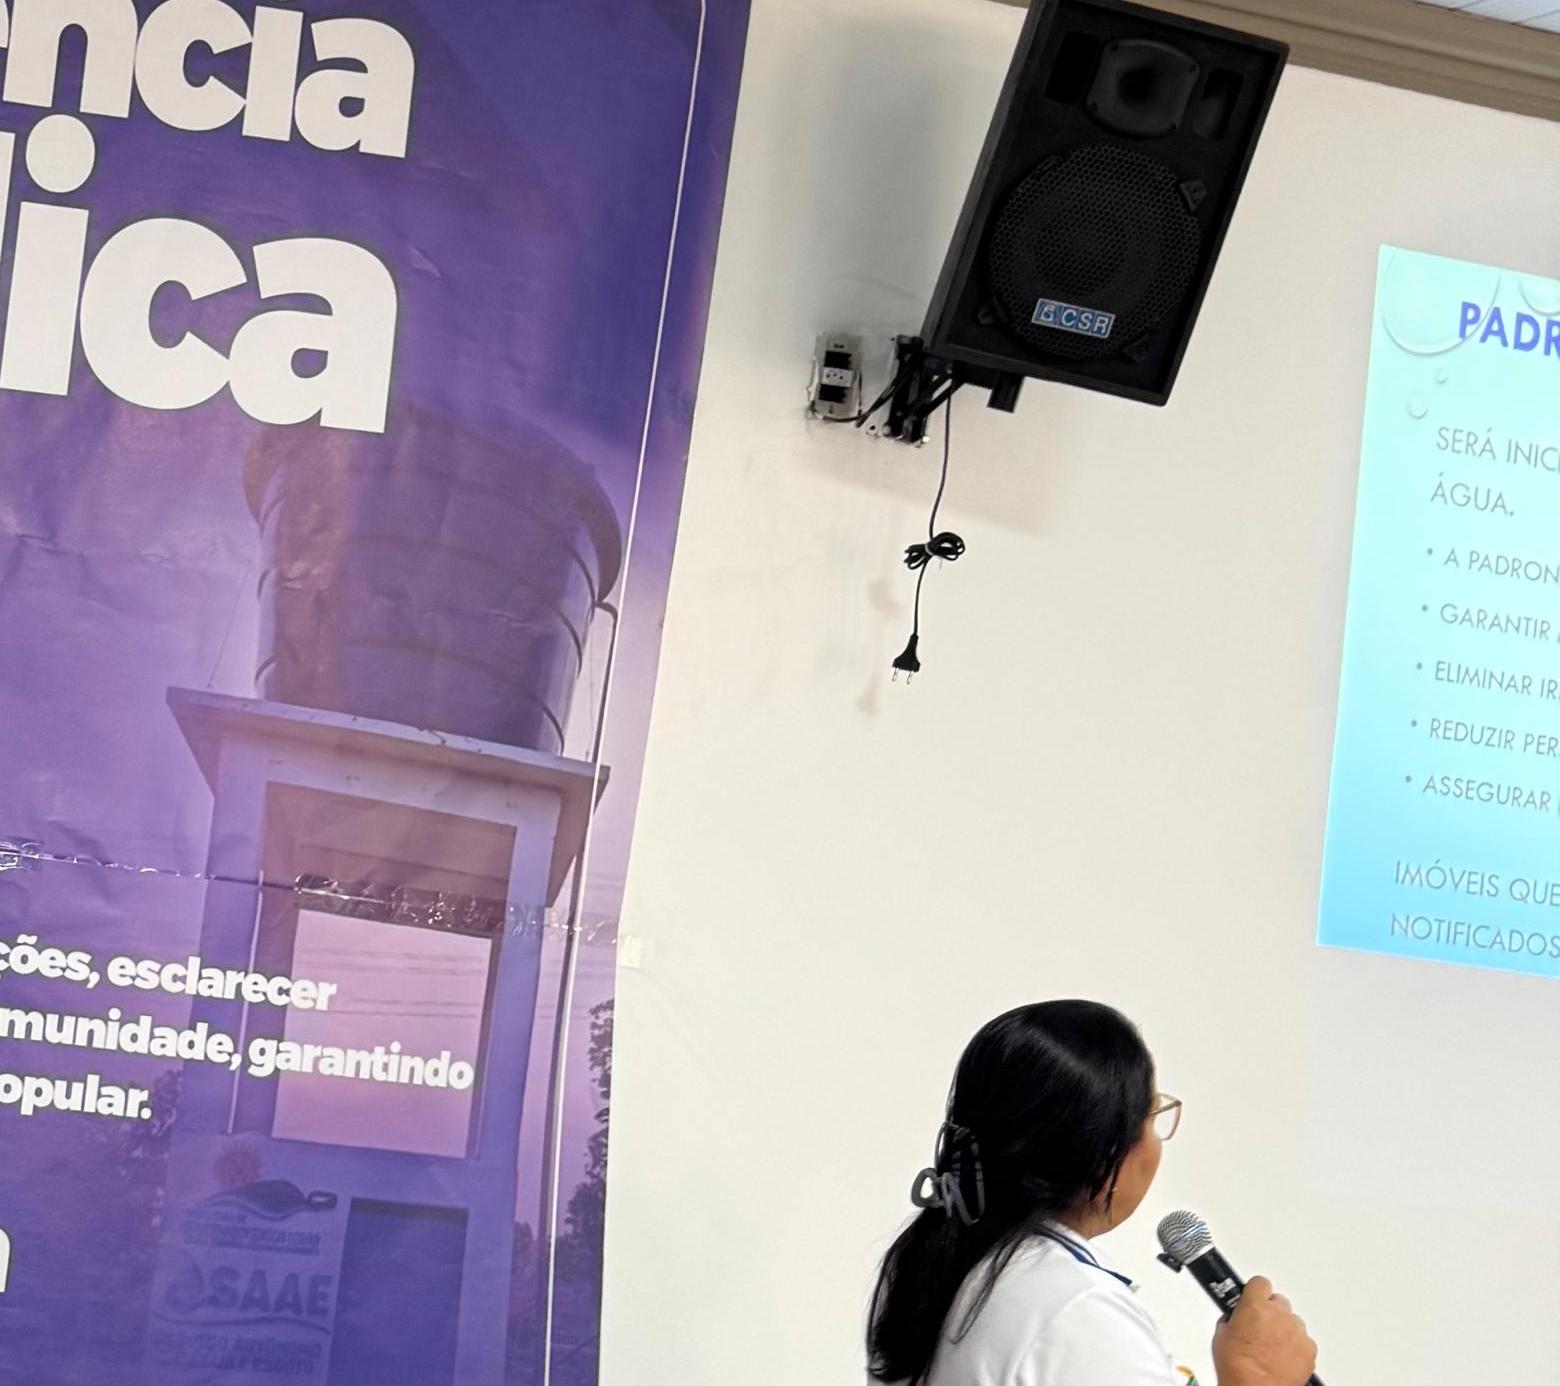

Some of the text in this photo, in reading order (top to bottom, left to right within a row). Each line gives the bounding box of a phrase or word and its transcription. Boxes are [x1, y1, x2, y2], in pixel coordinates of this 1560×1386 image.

[1436, 427, 1496, 460] SERÁ
[1430, 472, 1514, 515] ÁGUA.
[1443, 548, 1560, 584] A PADRON
[1440, 603, 1551, 642] GARANTIR
[1434, 660, 1560, 701] ELIMINAR IR
[1429, 718, 1560, 758] REDUZIR PER
[1423, 775, 1551, 812] ASSEGURAR
[1395, 859, 1560, 908] IMÓVEIS QUE
[1390, 914, 1560, 959] NOTIFICADOS
[106, 957, 337, 1011] esclarecer
[248, 1041, 475, 1091] garantindo
